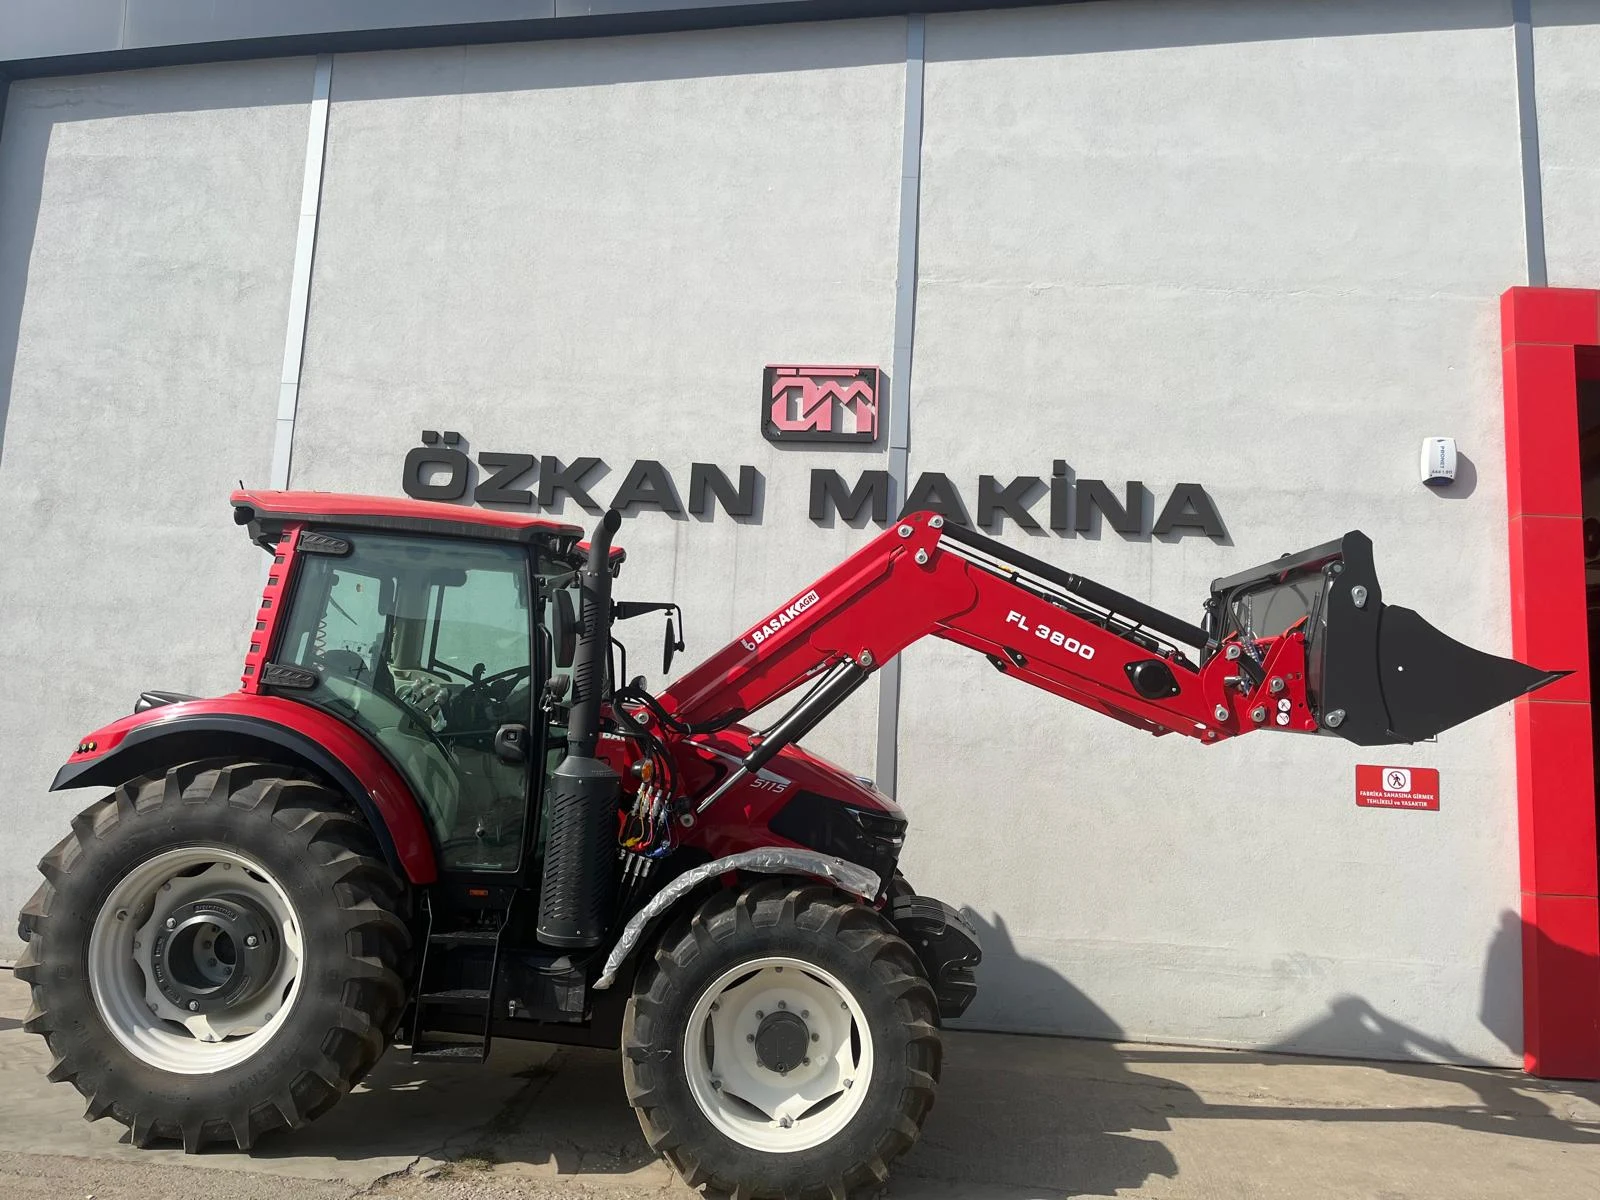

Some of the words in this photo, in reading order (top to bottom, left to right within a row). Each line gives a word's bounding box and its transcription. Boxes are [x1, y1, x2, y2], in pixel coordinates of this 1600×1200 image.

[402, 430, 758, 517] ÖZKAN
[809, 459, 1226, 537] MAKİNA
[752, 604, 801, 645] BASAK
[799, 593, 817, 610] AGRI
[1006, 610, 1029, 631] FL
[1034, 624, 1095, 660] 3800
[750, 778, 788, 793] 5115
